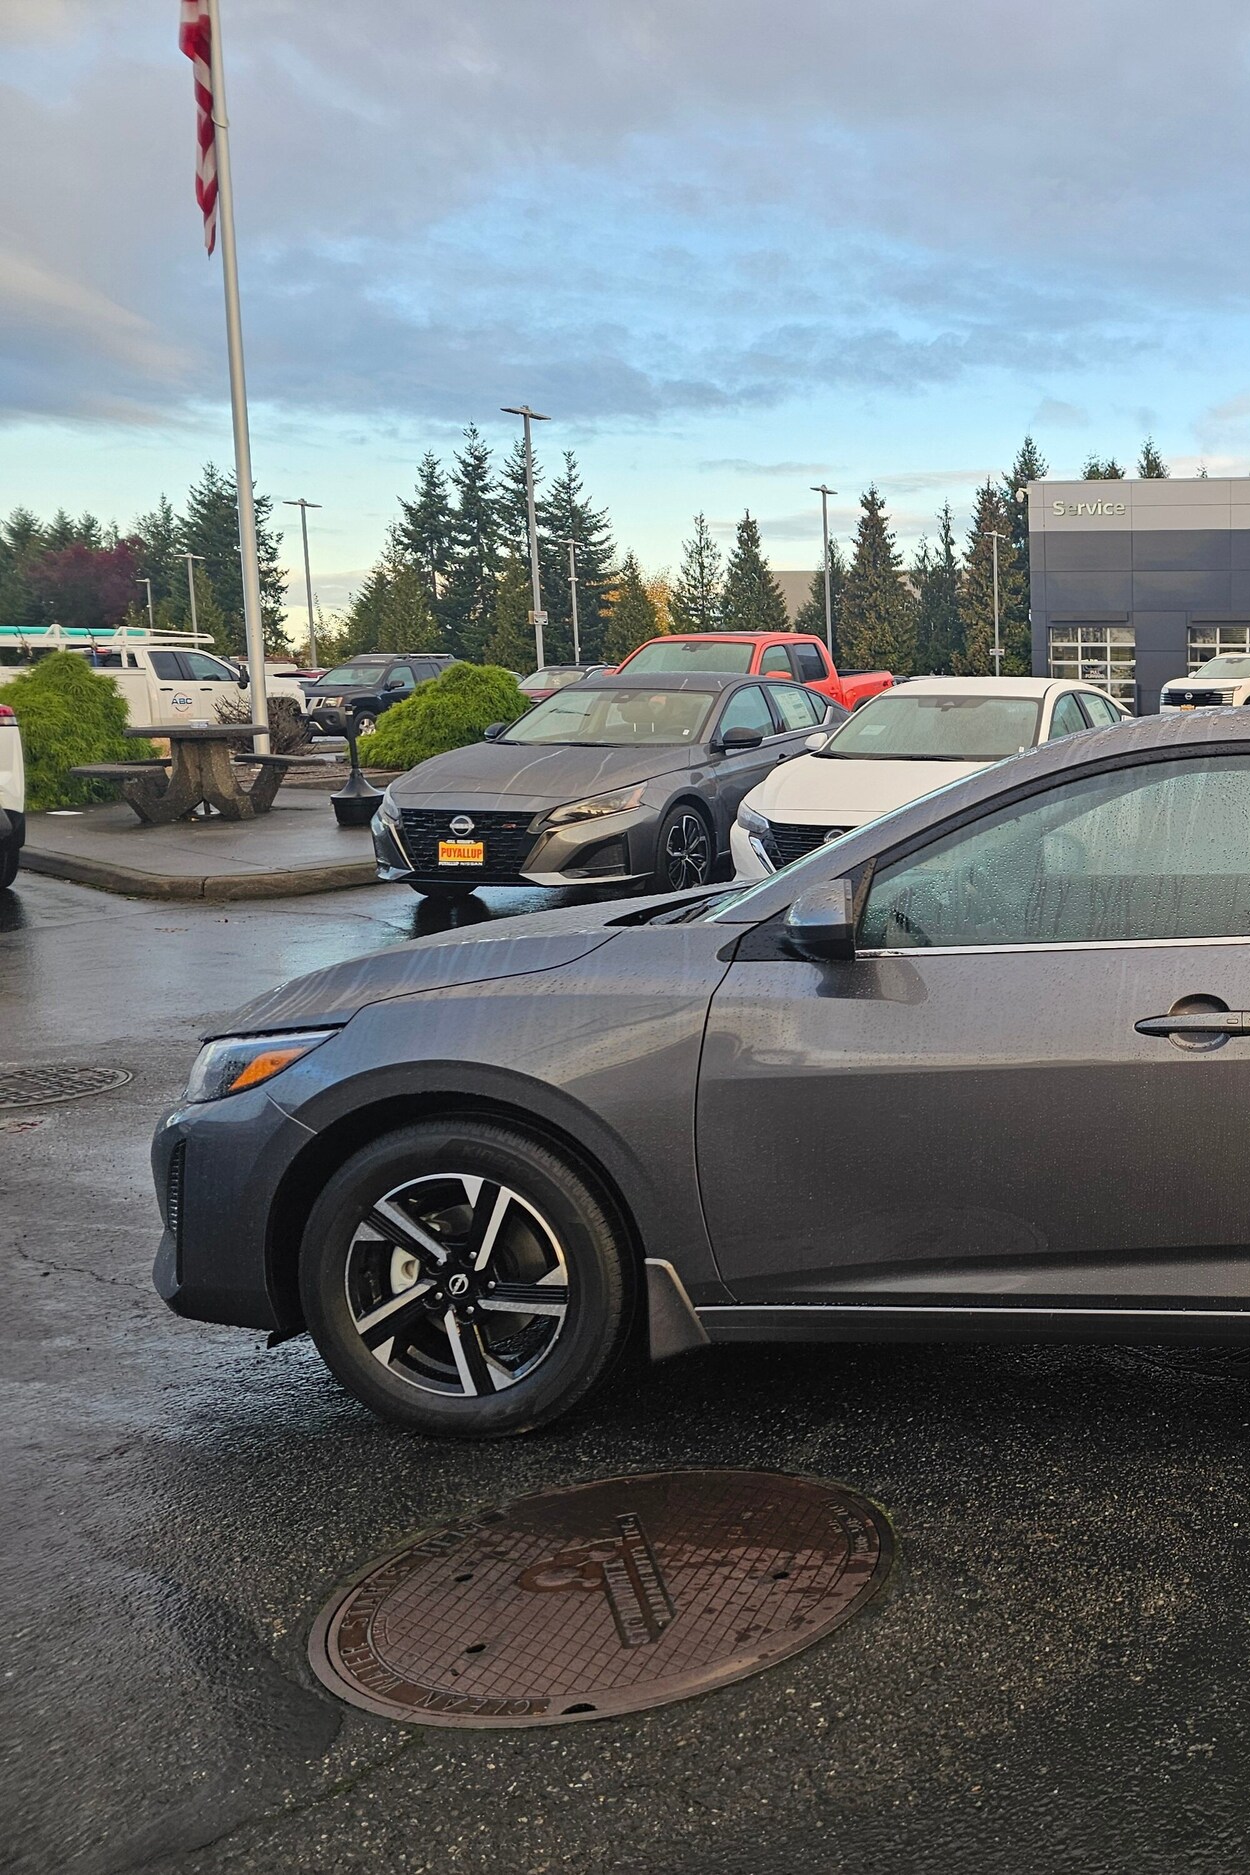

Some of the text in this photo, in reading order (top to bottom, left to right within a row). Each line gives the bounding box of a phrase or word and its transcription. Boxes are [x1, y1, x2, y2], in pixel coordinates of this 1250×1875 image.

[1052, 498, 1127, 517] Service
[171, 697, 193, 705] ABC
[440, 847, 483, 859] PUYALLUP
[341, 1567, 411, 1629] STARTS
[340, 1642, 404, 1694] WATER
[413, 1691, 531, 1716] CLEAN
